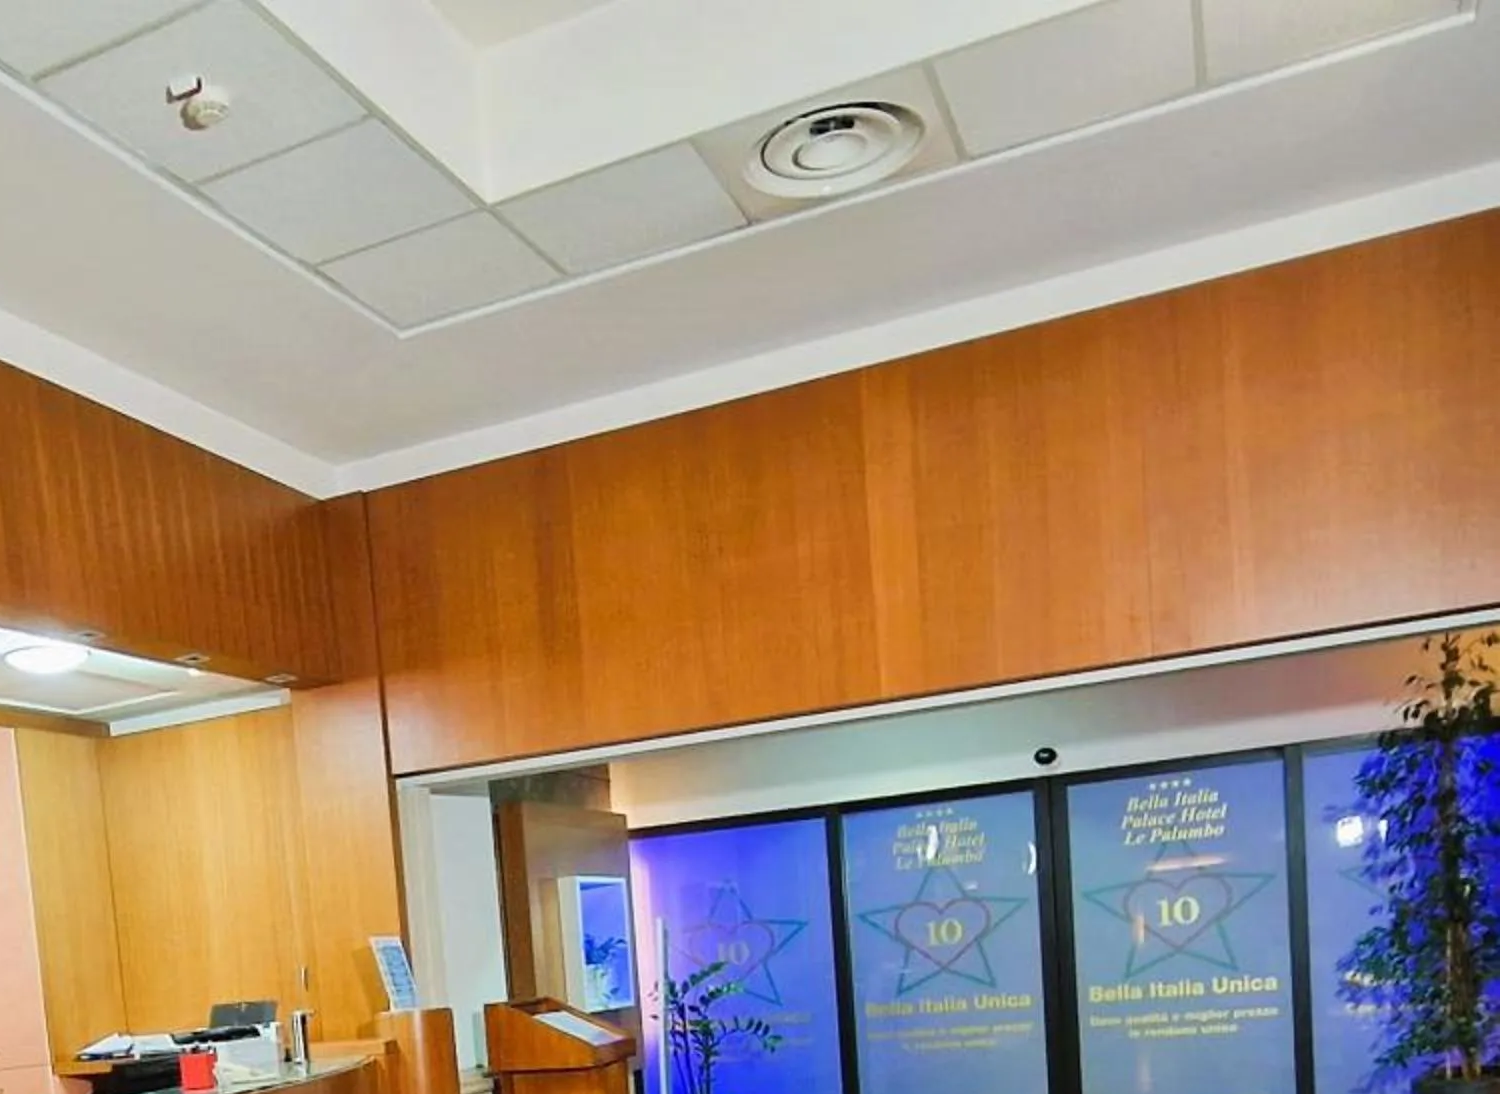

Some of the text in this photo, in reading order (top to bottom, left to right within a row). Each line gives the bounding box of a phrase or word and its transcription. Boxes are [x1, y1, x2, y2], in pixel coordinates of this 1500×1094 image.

[1126, 789, 1219, 812] Bella Italia
[1121, 802, 1228, 830] Palace Hotel
[1124, 824, 1225, 845] Le Palumbo
[1157, 896, 1200, 928] 10
[925, 918, 964, 946] 10
[717, 941, 750, 965] 10
[974, 993, 1032, 1010] Unica
[1089, 975, 1278, 1003] Bella Italia Unica
